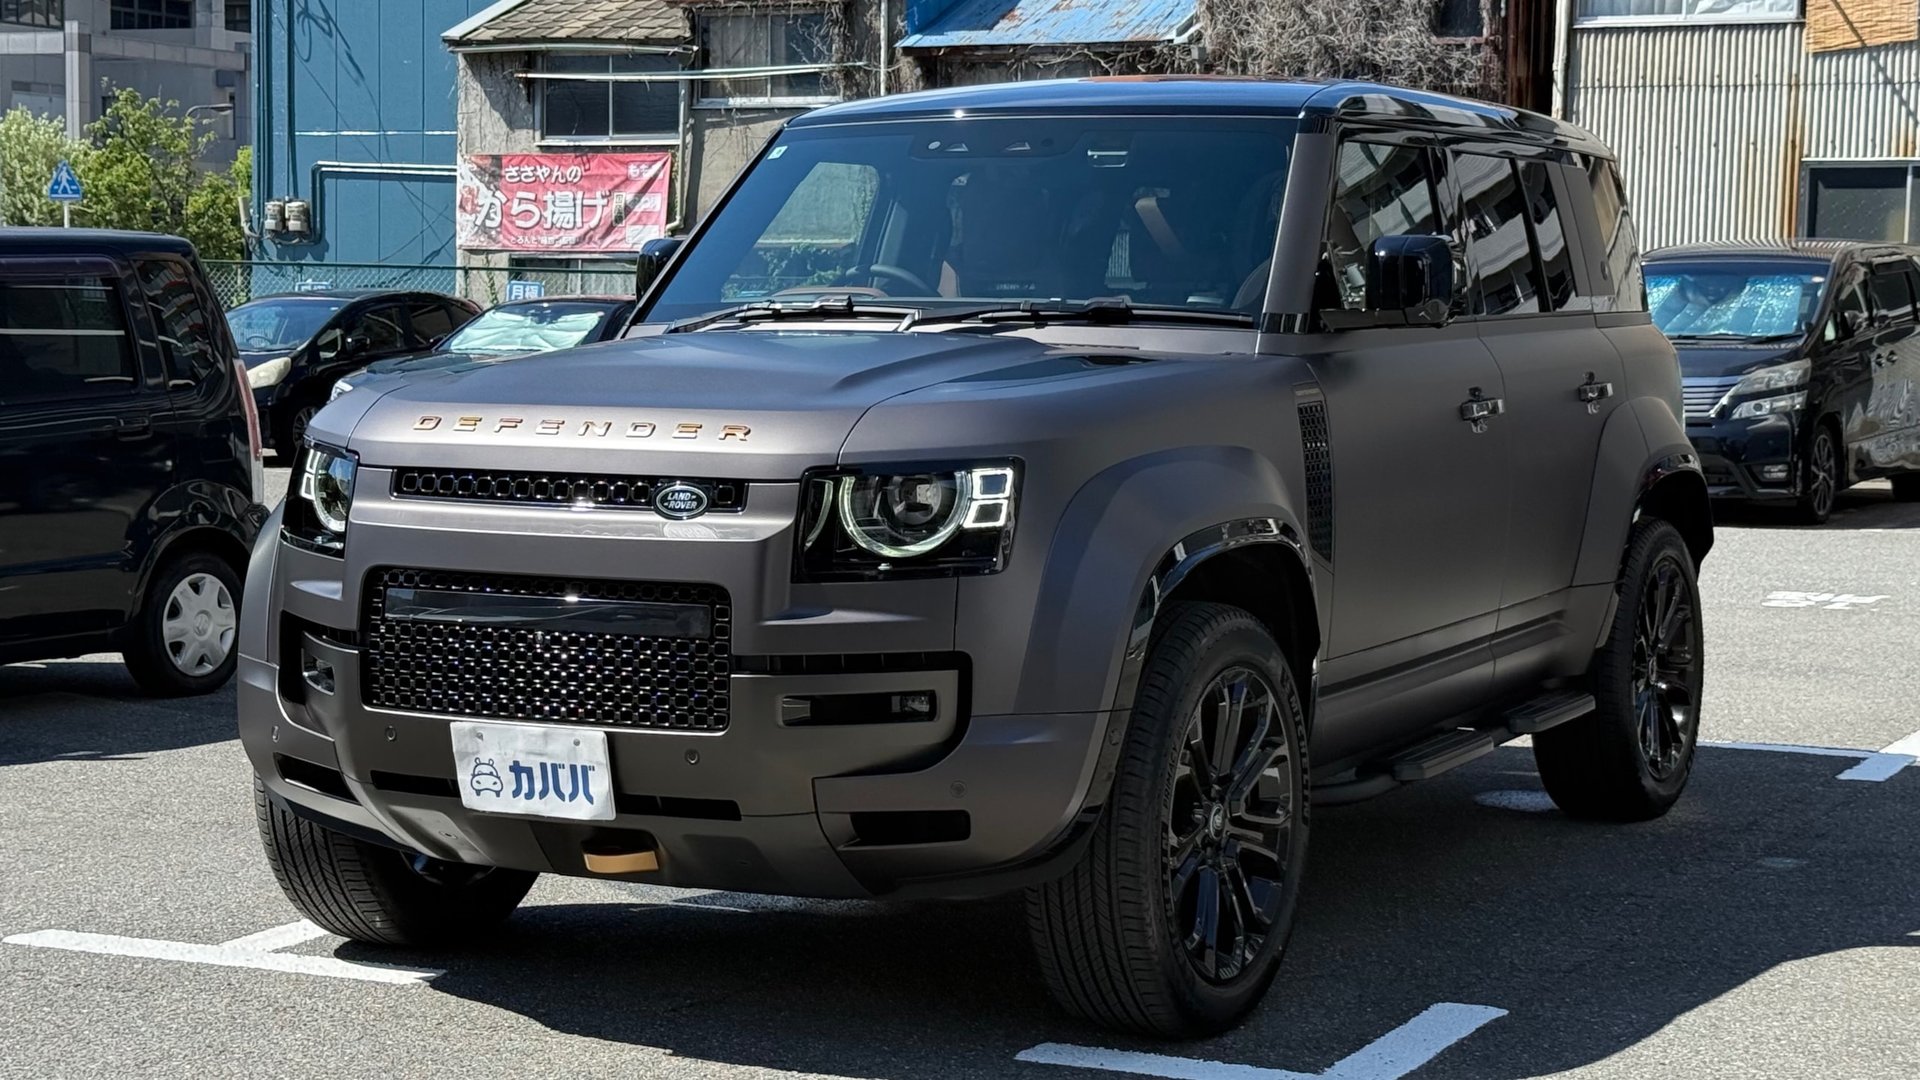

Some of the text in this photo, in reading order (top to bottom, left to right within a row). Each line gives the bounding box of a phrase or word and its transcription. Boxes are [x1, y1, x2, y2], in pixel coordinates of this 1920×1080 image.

[504, 166, 582, 184] ささやんの
[475, 190, 612, 229] から揚げ
[413, 415, 752, 441] DEFENDER
[667, 493, 692, 502] LAND
[667, 502, 698, 511] ROVER
[508, 760, 596, 805] カババ
